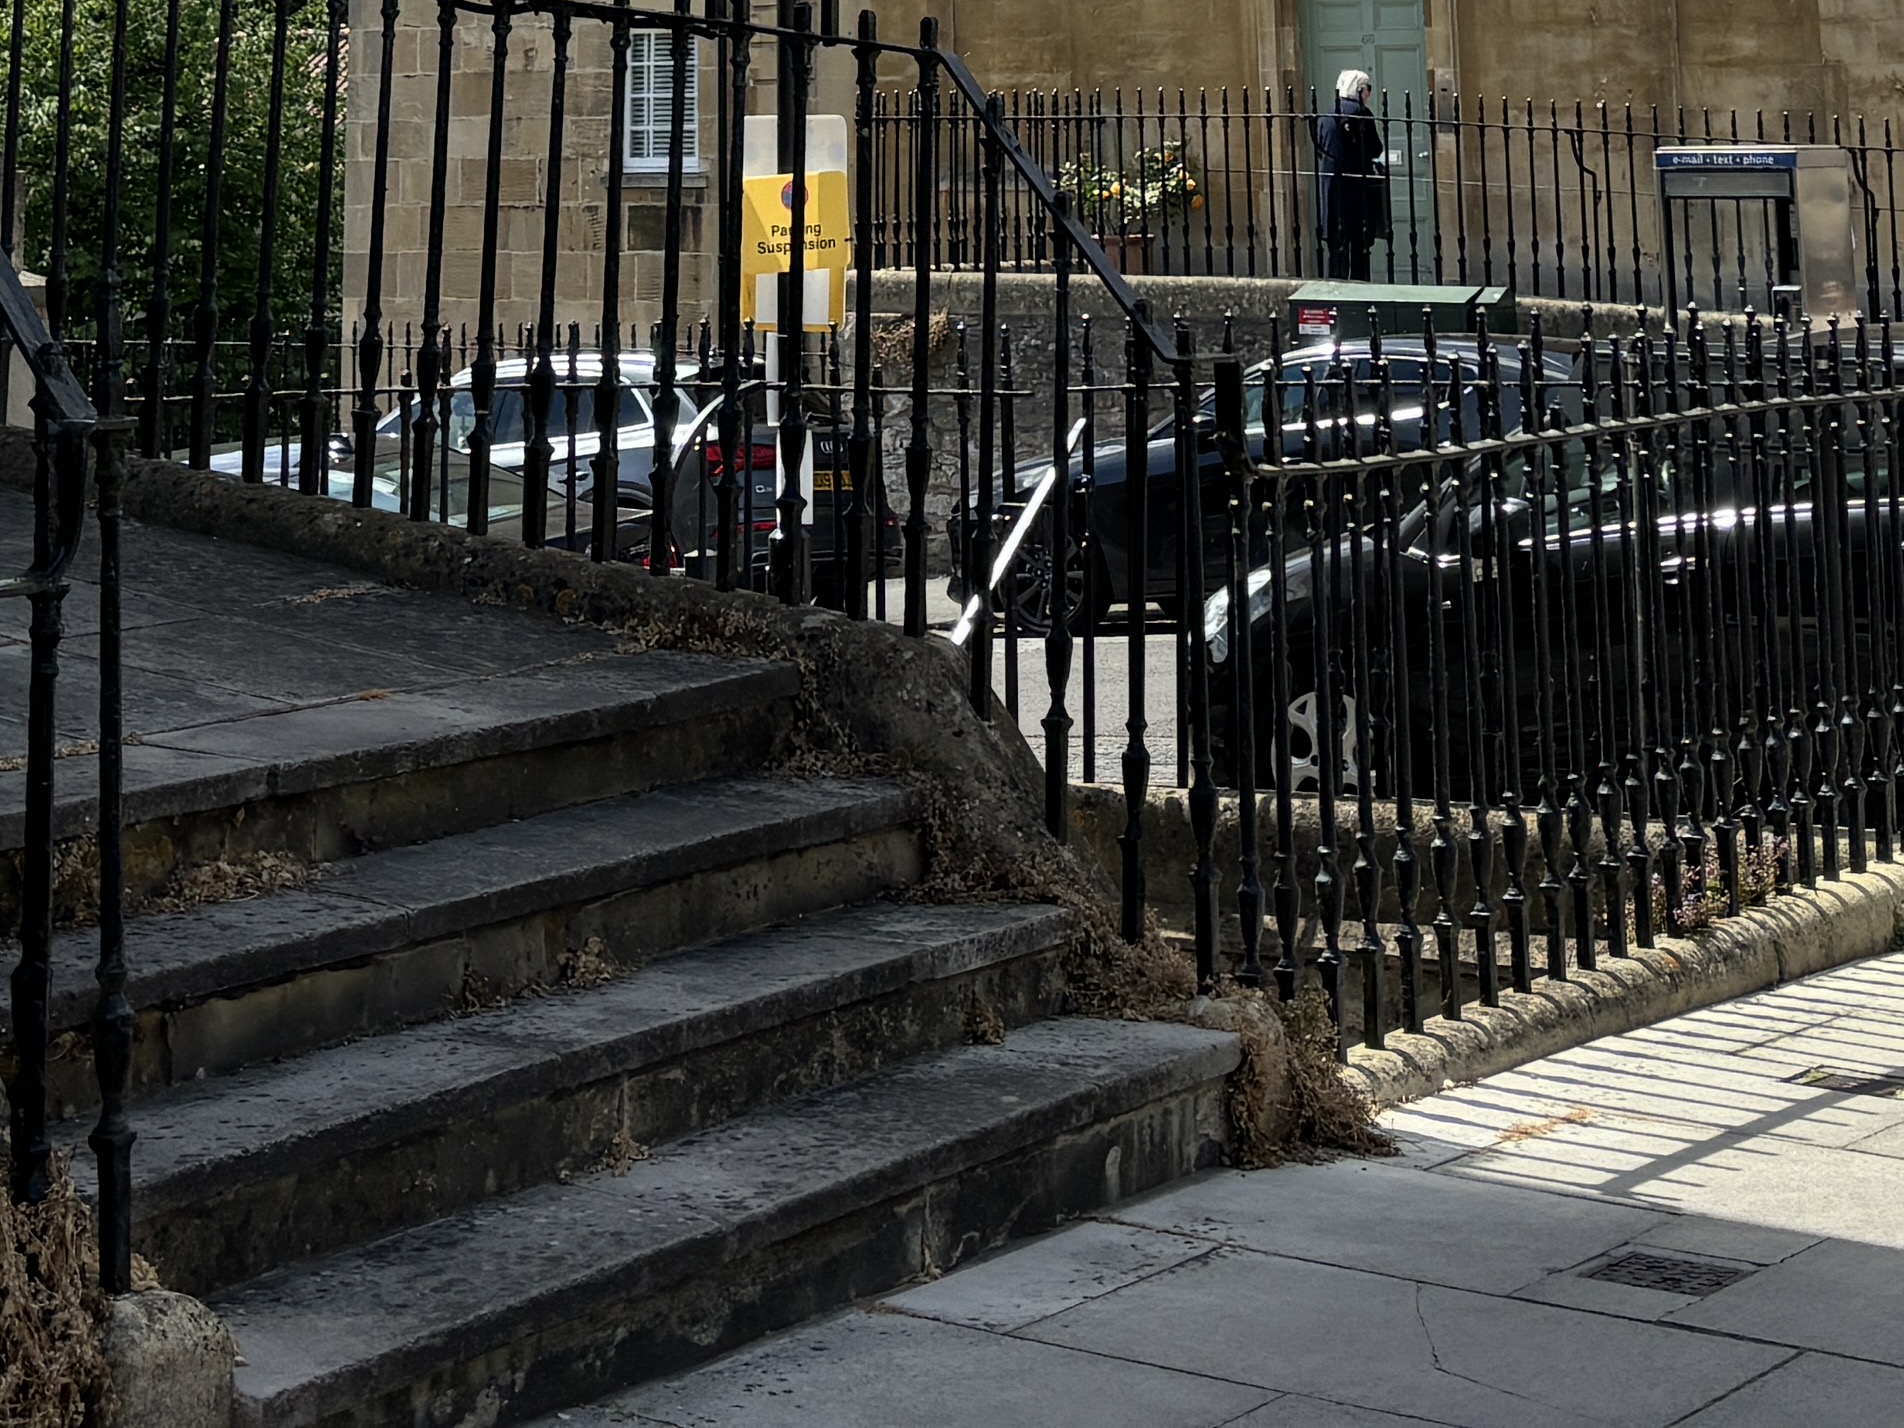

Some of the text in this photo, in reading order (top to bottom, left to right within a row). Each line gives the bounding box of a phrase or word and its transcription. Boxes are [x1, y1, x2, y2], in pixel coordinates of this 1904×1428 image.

[1672, 154, 1774, 165] e-mail text phone
[757, 238, 836, 255] Suspnsion
